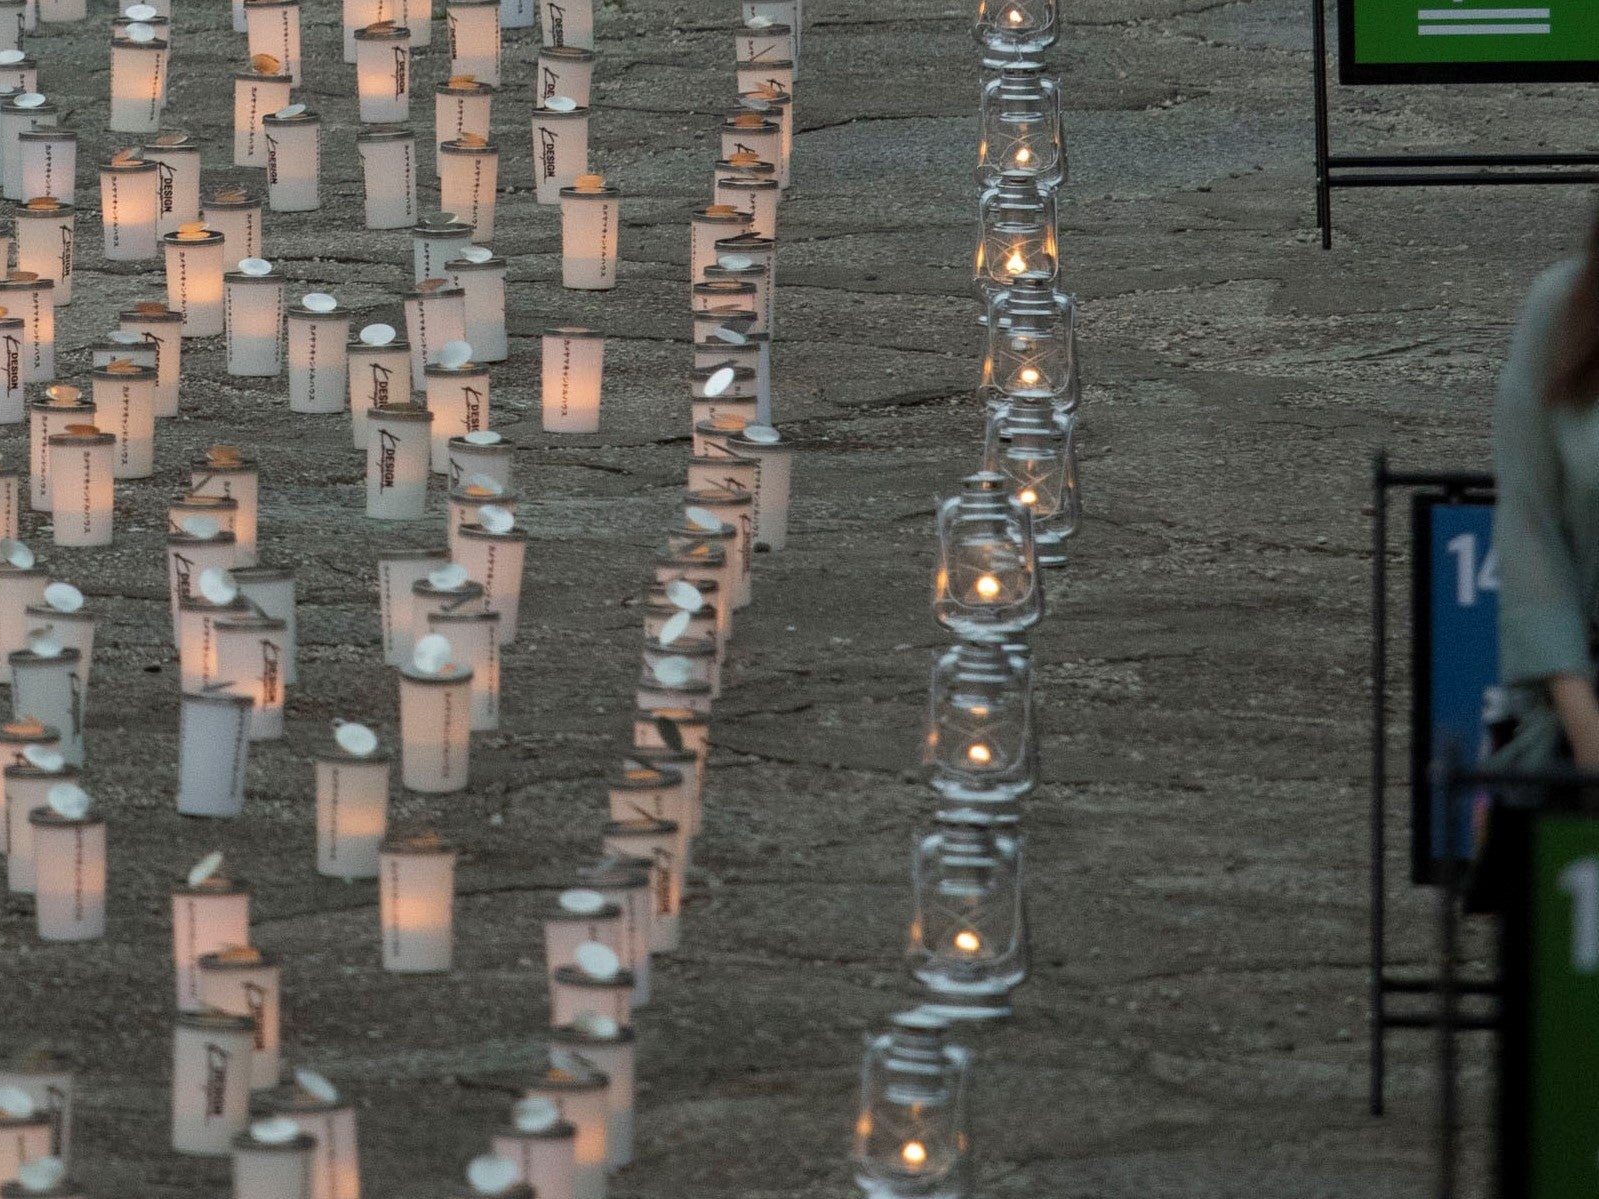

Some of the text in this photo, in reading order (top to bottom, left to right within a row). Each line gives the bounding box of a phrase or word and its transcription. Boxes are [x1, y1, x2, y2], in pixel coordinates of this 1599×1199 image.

[270, 150, 278, 185] DESIGN
[546, 143, 554, 178] DESIGN
[164, 177, 173, 213] DESIGN
[10, 352, 18, 390] DESIGN
[385, 448, 394, 488] DESIGN
